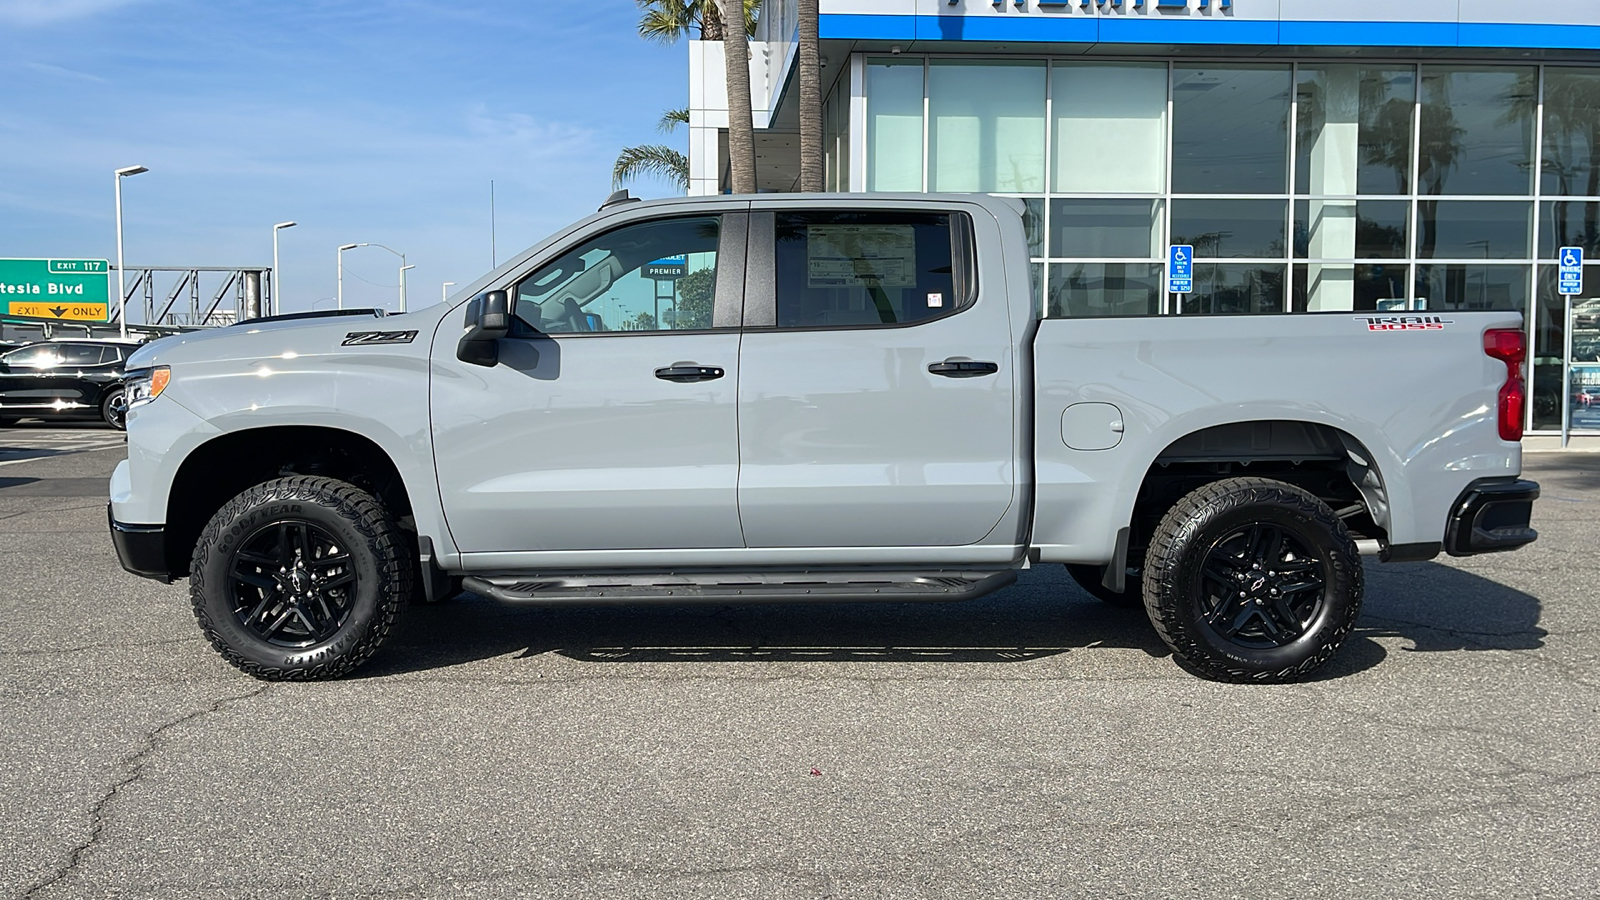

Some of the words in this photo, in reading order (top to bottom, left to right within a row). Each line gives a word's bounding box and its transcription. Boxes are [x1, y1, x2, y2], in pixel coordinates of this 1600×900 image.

[57, 262, 76, 270] EXIT
[83, 262, 101, 271] 117
[48, 283, 84, 294] Blvd
[73, 307, 102, 316] ONLY
[1353, 316, 1454, 325] TRAIL
[218, 504, 303, 555] GOODYEAR
